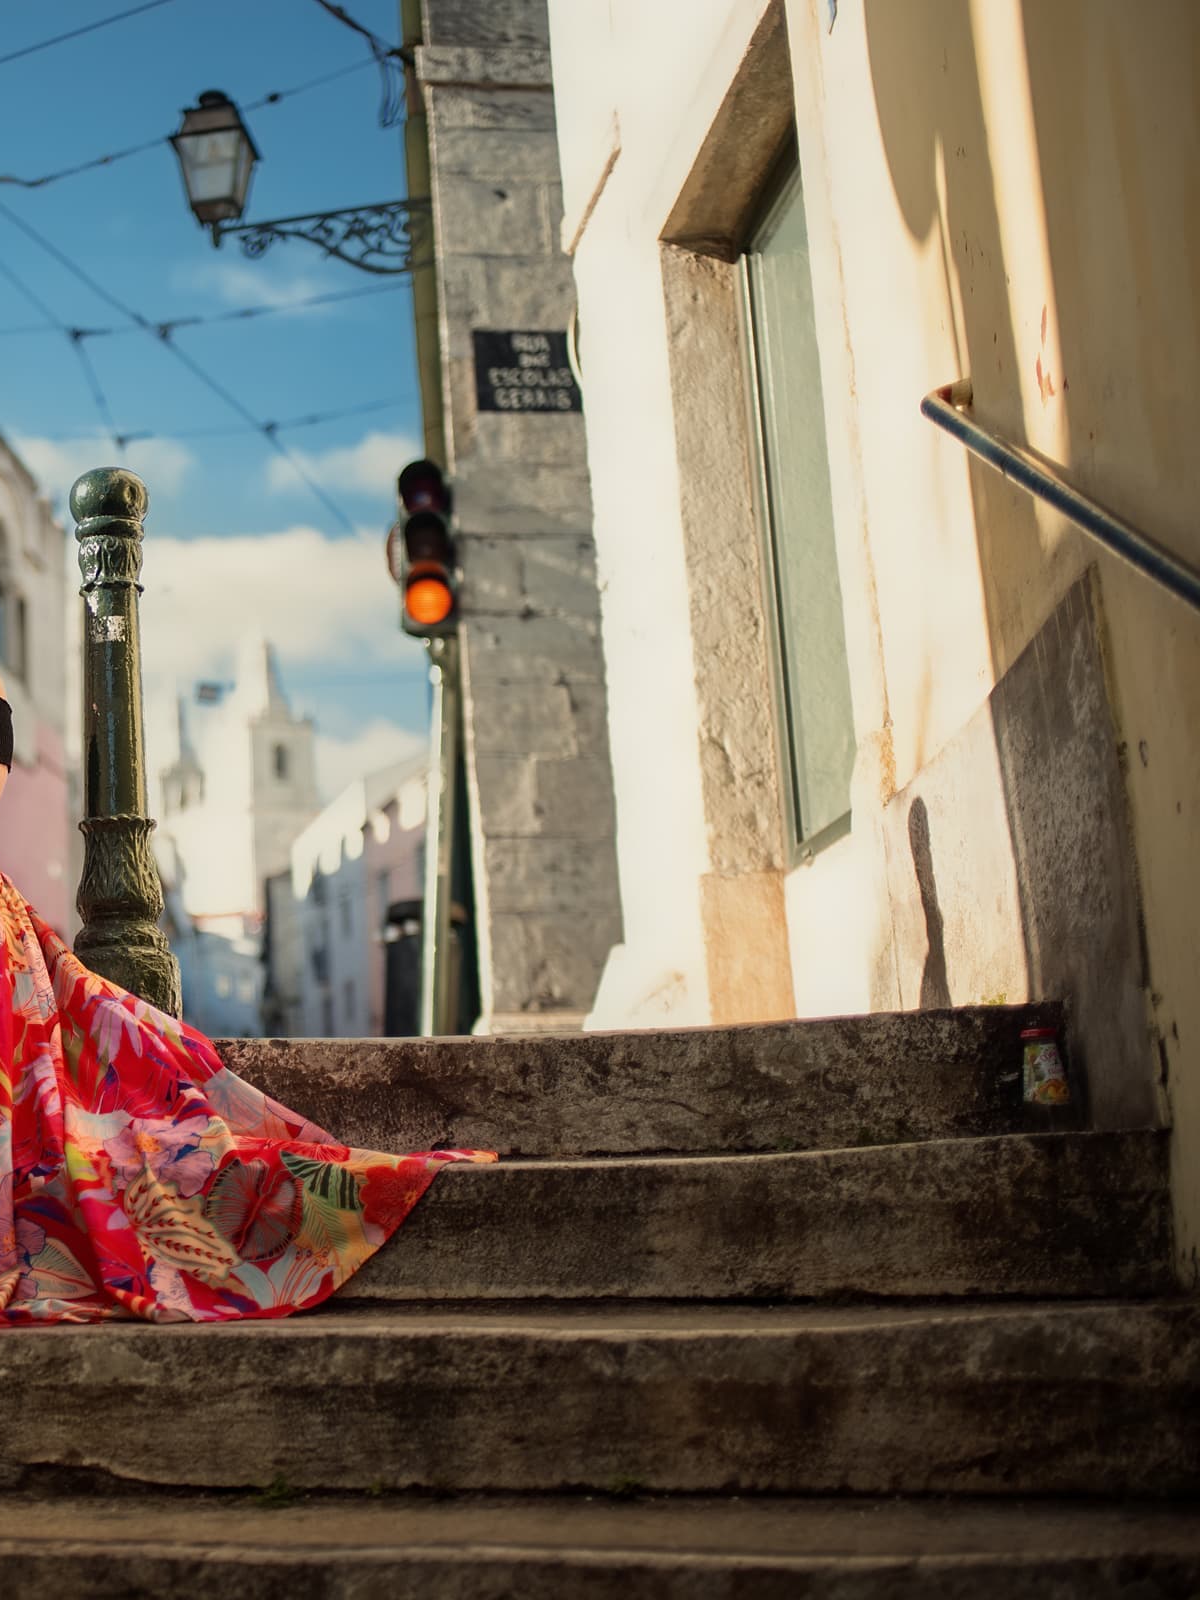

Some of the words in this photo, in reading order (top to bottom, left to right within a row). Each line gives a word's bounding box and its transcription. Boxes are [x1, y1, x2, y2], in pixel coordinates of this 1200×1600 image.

[511, 333, 550, 352] RUA
[488, 368, 573, 387] ESCOLAS
[495, 387, 572, 409] GERAIS
